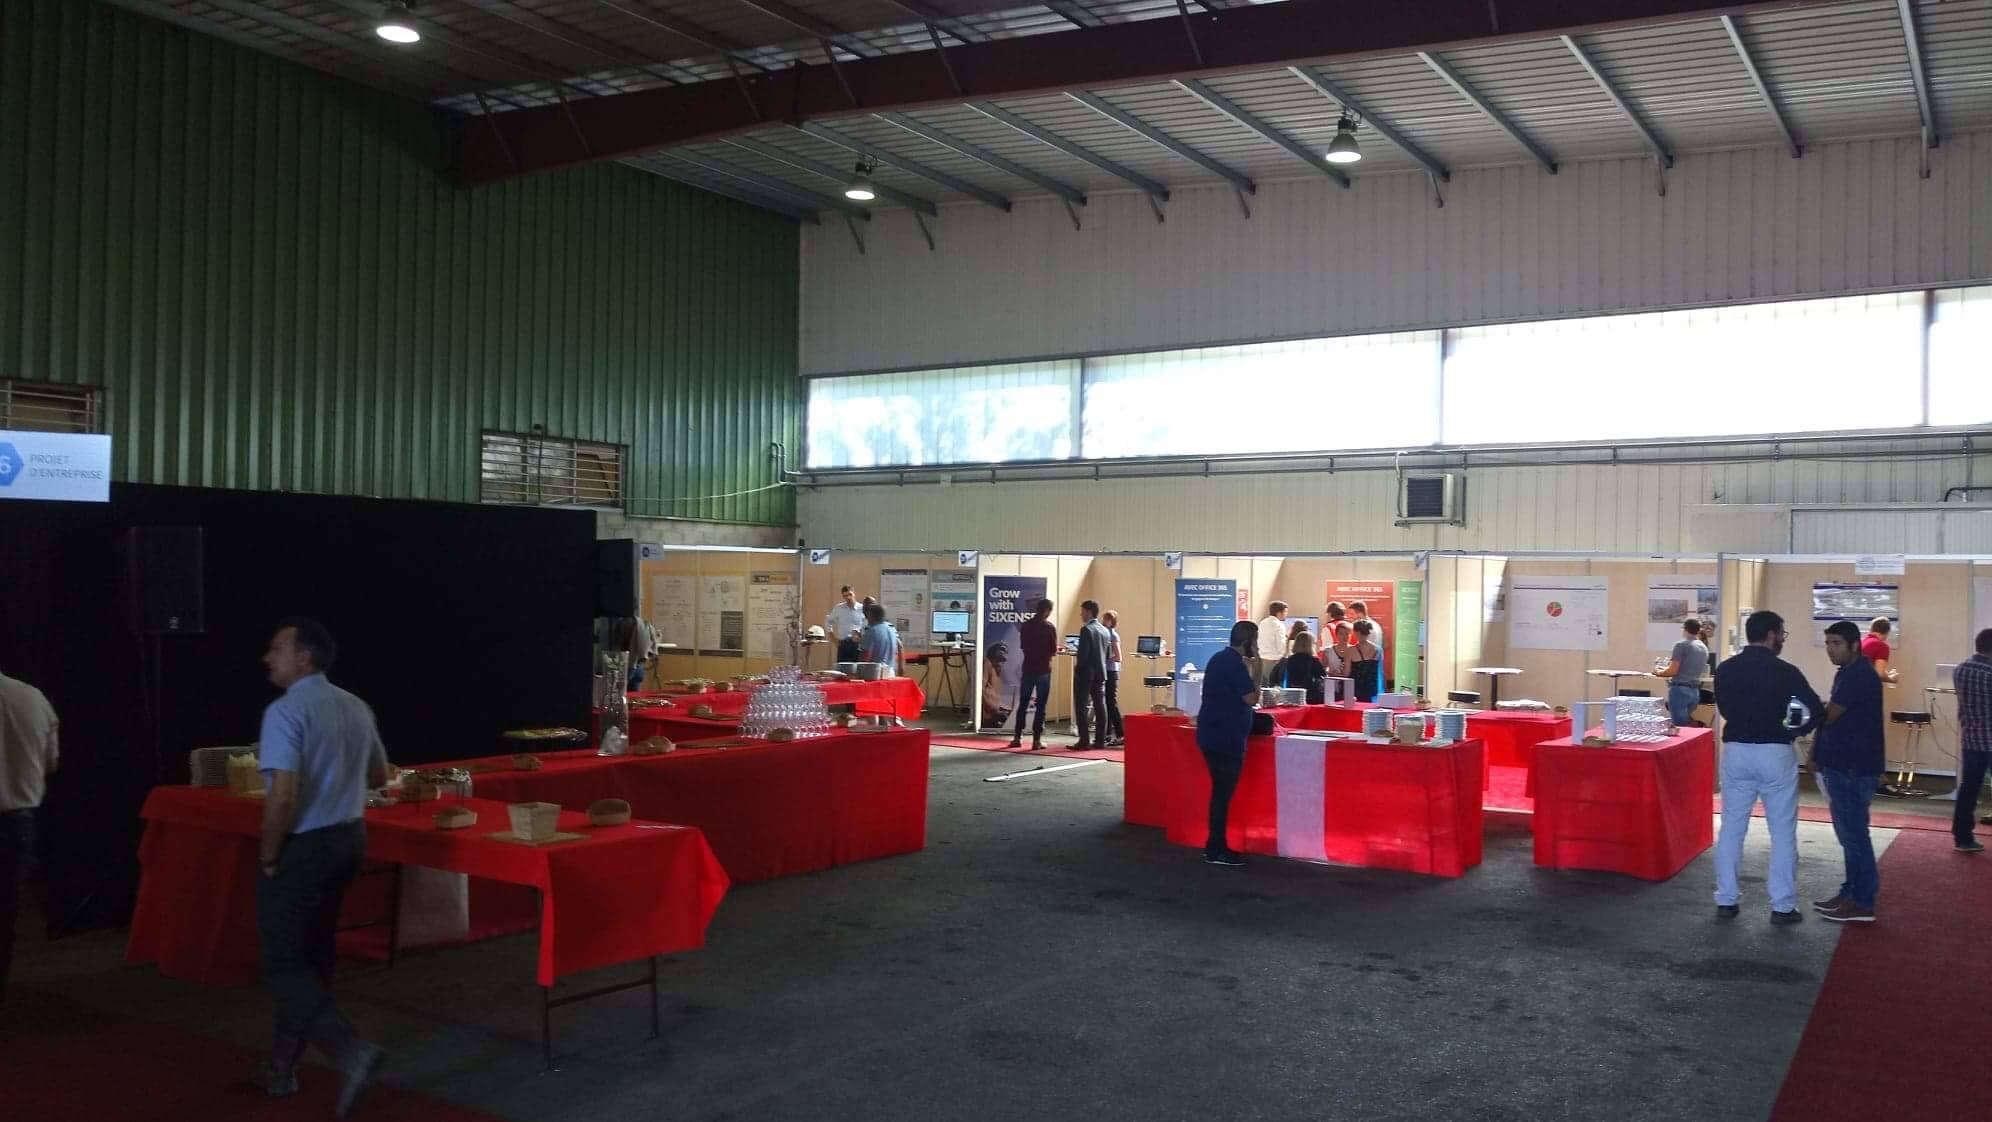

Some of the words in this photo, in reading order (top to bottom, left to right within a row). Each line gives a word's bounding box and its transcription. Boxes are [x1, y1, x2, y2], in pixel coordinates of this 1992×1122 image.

[30, 454, 70, 465] PROJET
[30, 468, 104, 480] D'ENTREPRISE
[989, 587, 1021, 598] Grow
[989, 599, 1014, 610] with
